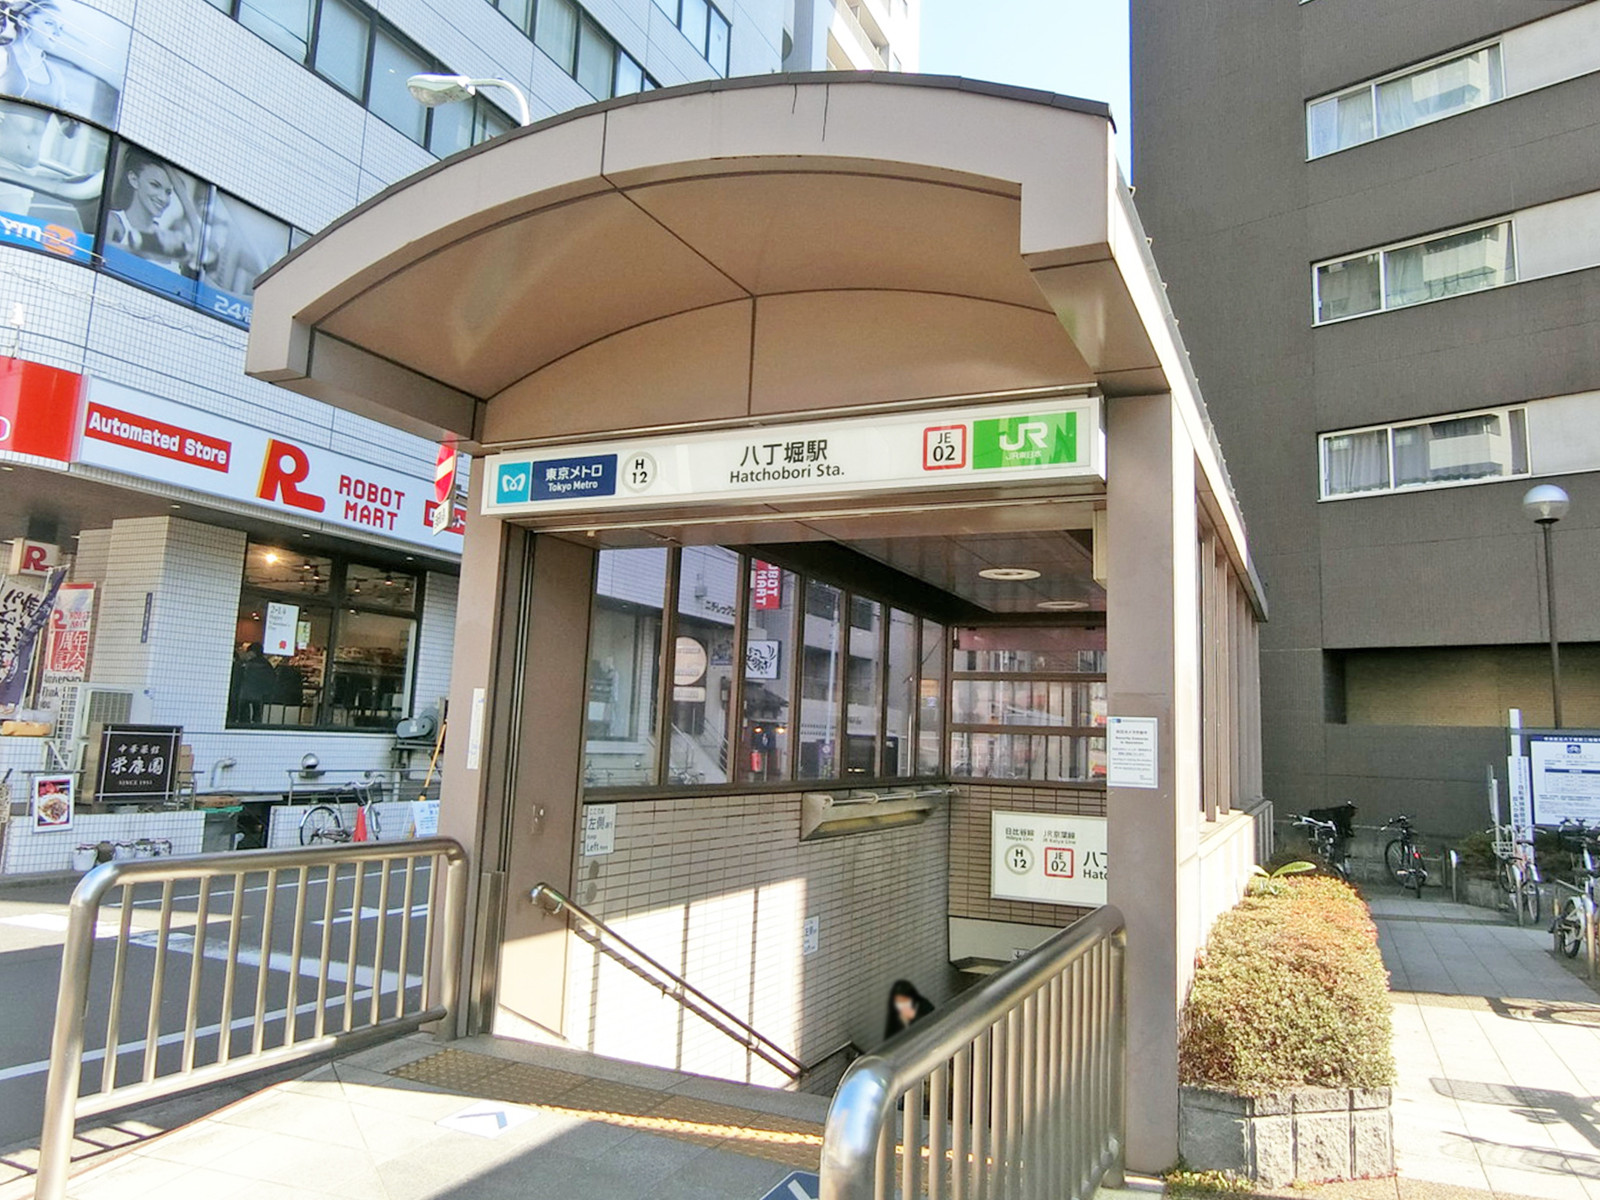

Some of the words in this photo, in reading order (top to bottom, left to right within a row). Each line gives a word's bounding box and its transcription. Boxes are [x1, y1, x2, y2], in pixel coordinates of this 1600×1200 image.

[88, 411, 180, 452] Automated
[184, 438, 227, 465] Store
[937, 432, 951, 444] JE
[1000, 422, 1048, 451] JR
[740, 439, 828, 467] 八丁堀駅
[933, 445, 955, 462] 02
[1005, 451, 1042, 460] JR東日本
[635, 459, 645, 470] H
[256, 438, 326, 513] R
[545, 464, 603, 482] 東京メトロ
[632, 471, 648, 484] 12
[729, 464, 812, 483] Hatchobori
[816, 463, 845, 477] Sta.
[339, 474, 405, 510] ROBOT
[548, 481, 572, 493] Tokyo
[573, 479, 598, 491] Metro
[344, 500, 398, 531] MART
[755, 569, 767, 605] MART
[1005, 827, 1035, 837] 日比谷線
[1015, 849, 1024, 858] H
[1054, 852, 1064, 860] JE
[1013, 858, 1028, 869] 12
[1051, 860, 1067, 872] 02
